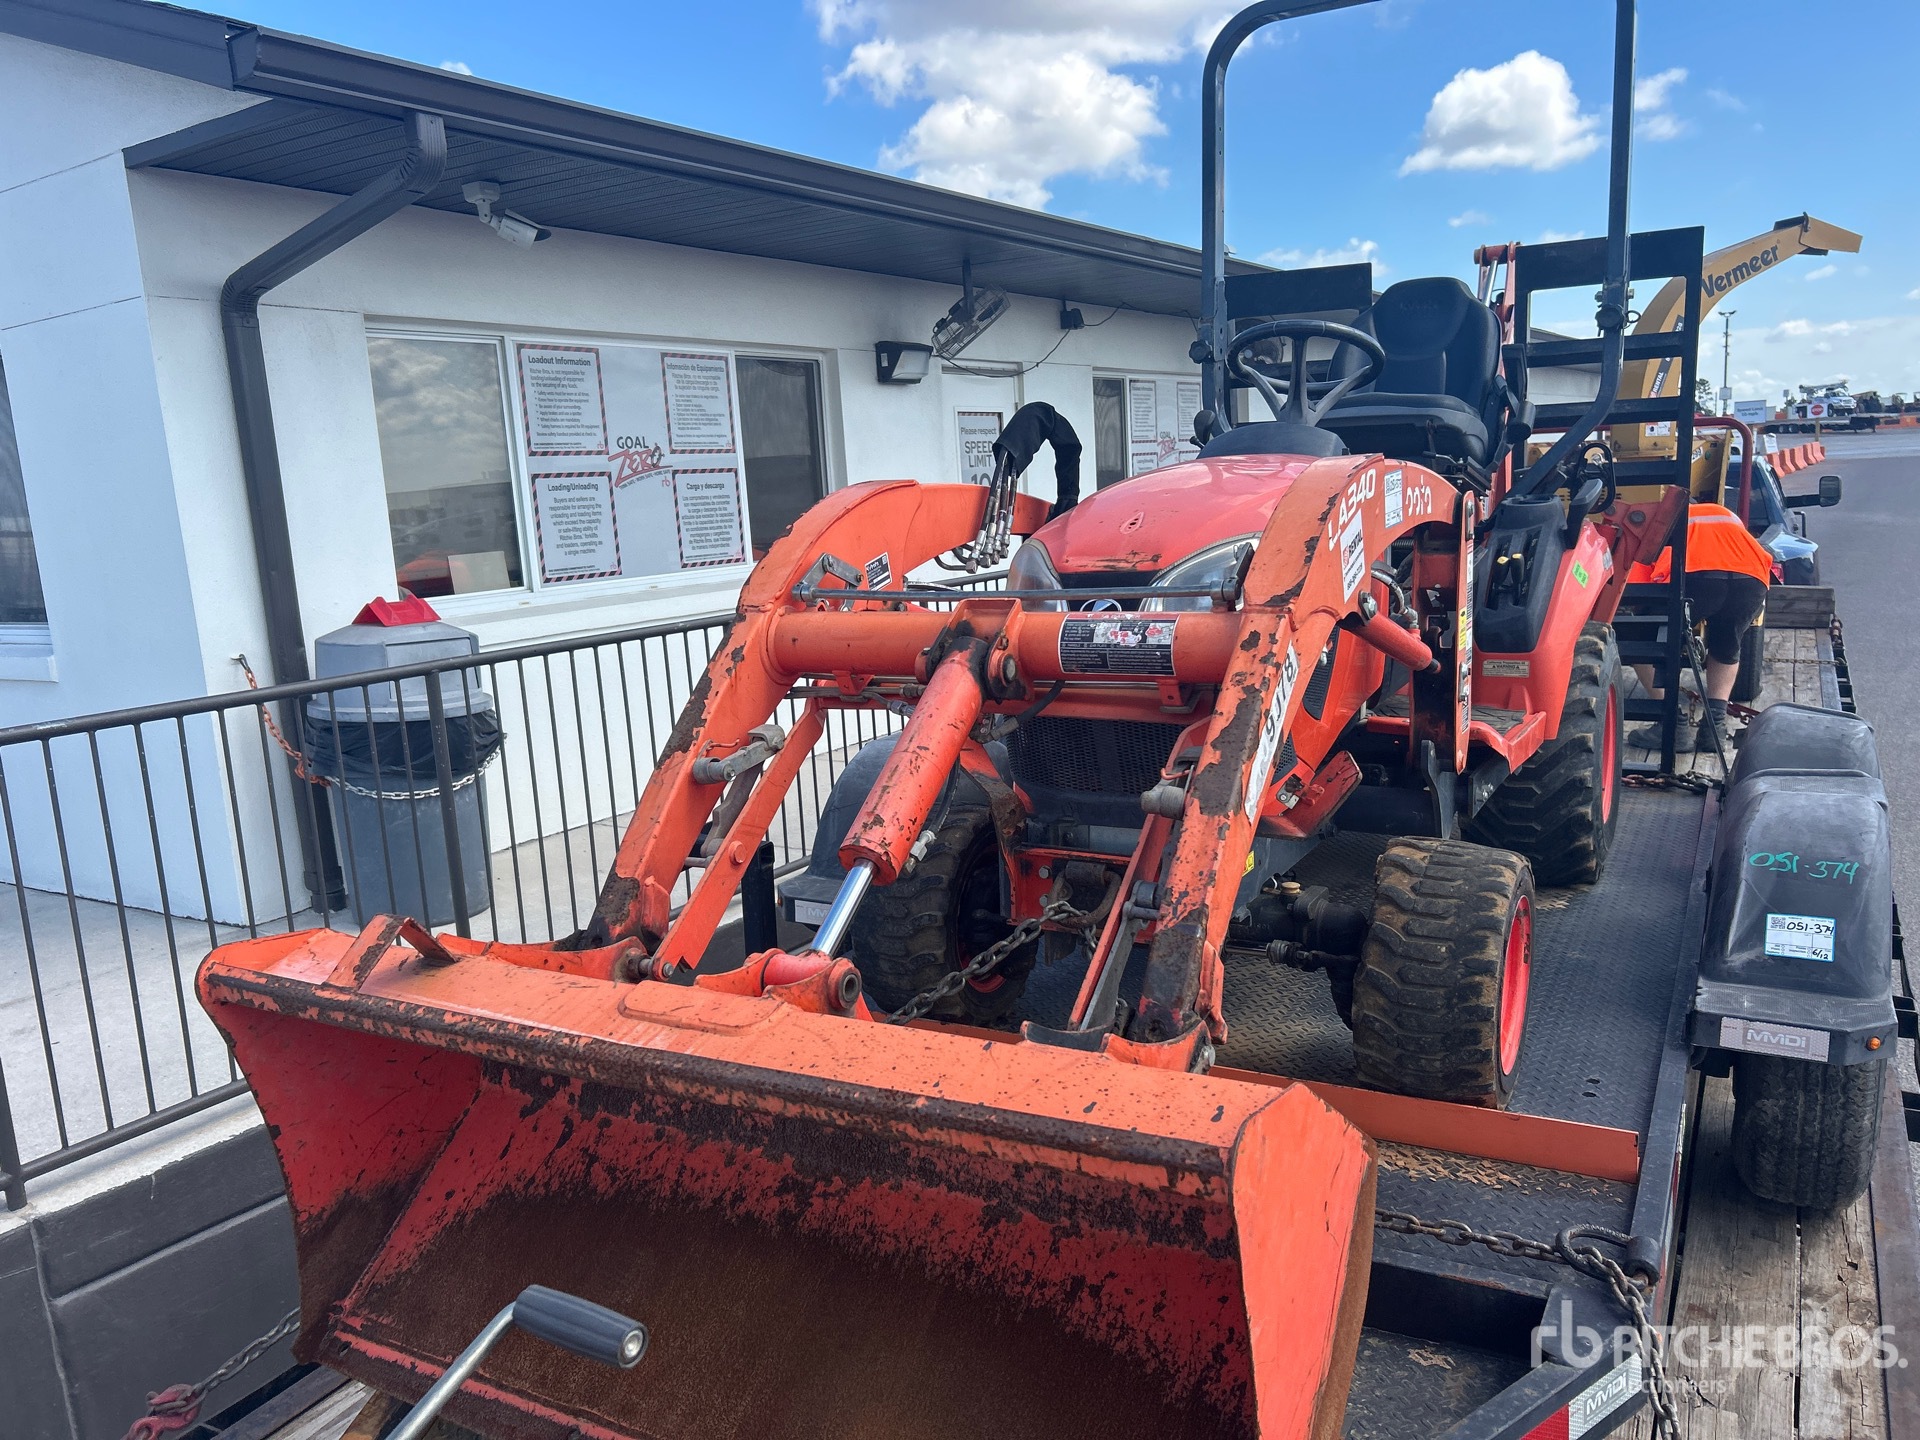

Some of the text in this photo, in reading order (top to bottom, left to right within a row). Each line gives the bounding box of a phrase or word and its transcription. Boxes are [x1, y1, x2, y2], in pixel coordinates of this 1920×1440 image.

[1702, 244, 1778, 298] Vermeer
[528, 356, 591, 366] Loadout Information
[1653, 372, 1664, 392] RENTAL
[961, 427, 996, 437] Please respect
[616, 436, 649, 449] GOAL
[965, 441, 993, 454] SPEED
[608, 442, 668, 487] ZERO
[968, 455, 992, 468] LIMIT
[548, 482, 598, 492] Loading/Unloading
[686, 483, 700, 491] Carga
[705, 482, 724, 490] descarga
[1328, 468, 1376, 552] LA340
[1812, 948, 1829, 960] 6/12
